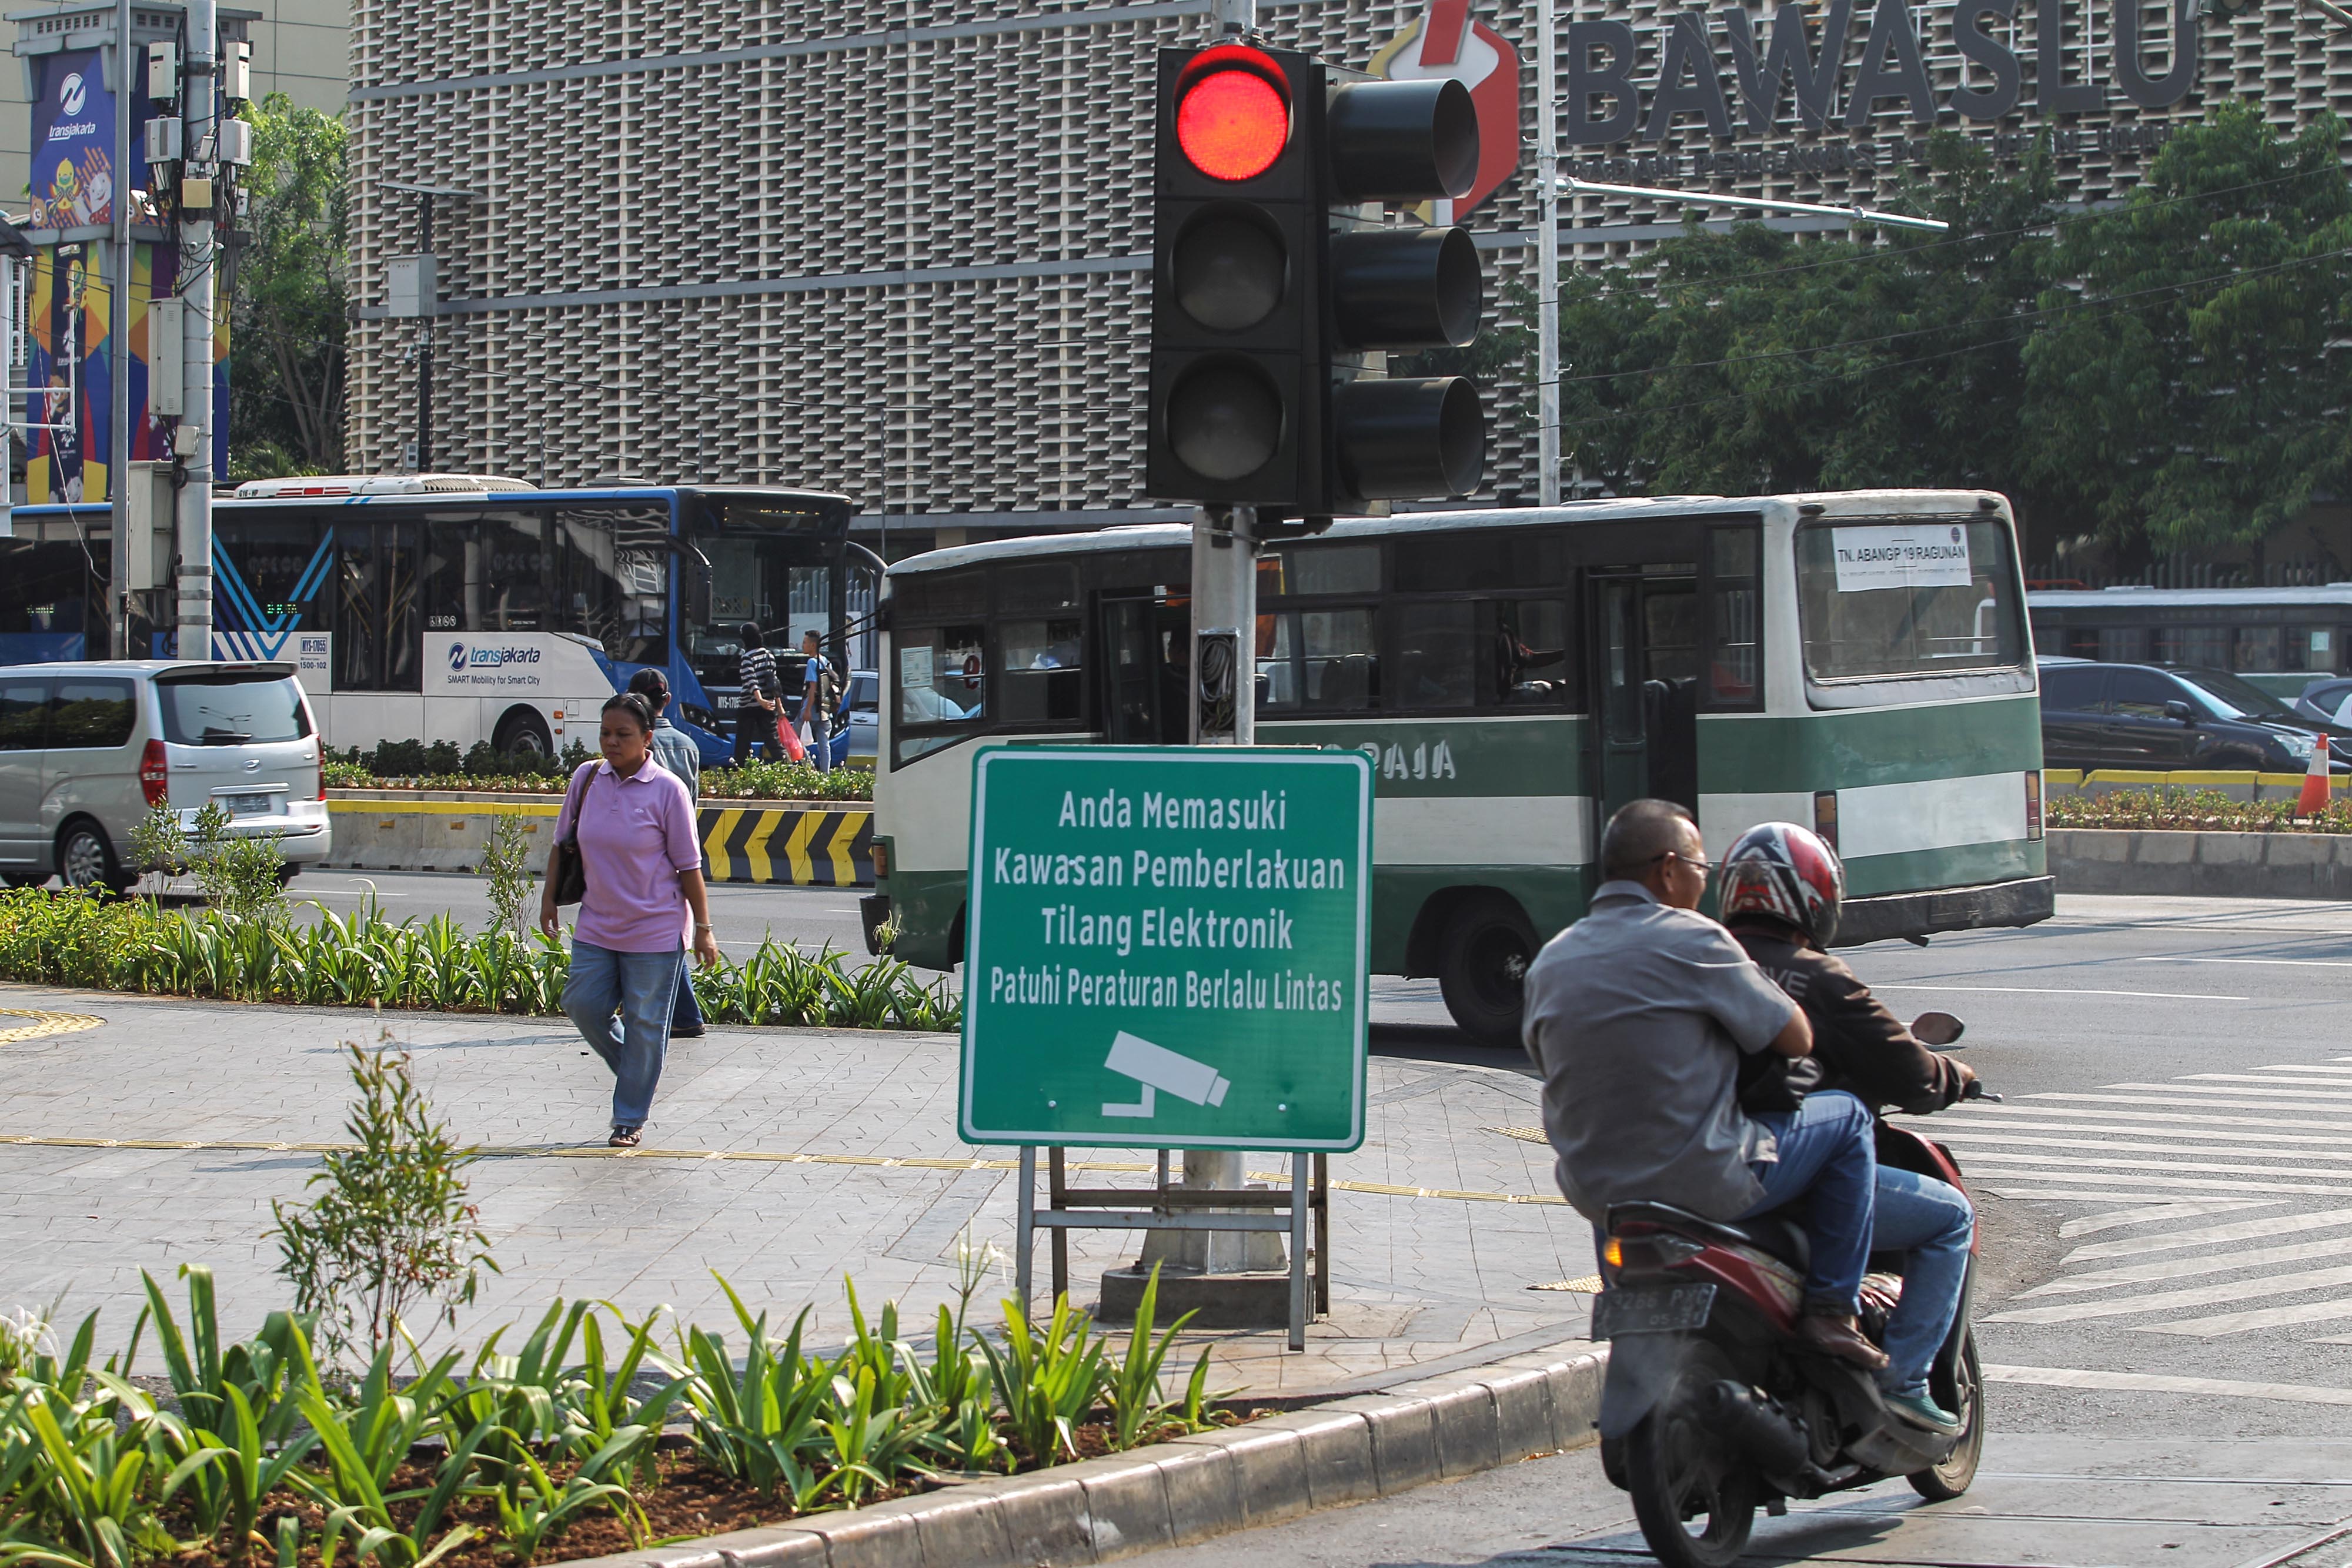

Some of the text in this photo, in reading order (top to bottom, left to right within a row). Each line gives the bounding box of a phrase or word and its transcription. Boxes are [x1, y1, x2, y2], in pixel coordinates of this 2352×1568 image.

[1567, 0, 2198, 145] BAWASLU
[49, 122, 96, 141] transjakarta
[1694, 143, 1875, 176] PENGAWAS
[2097, 123, 2174, 154] UMU
[1857, 547, 1893, 561] ABANG
[1916, 546, 1966, 560] RAGUNAN
[470, 647, 540, 667] transjakarta
[447, 676, 470, 684] SMART
[472, 676, 496, 686] Mobility
[497, 676, 506, 684] for
[527, 676, 540, 686] City
[1058, 788, 1286, 830] Anda Memasuki
[995, 847, 1344, 889] Kawasan Pemberlakuan
[1042, 904, 1293, 957] Tilang Elektronik
[990, 964, 1342, 1011] Patuhi Peraturan Berlalu Lintas
